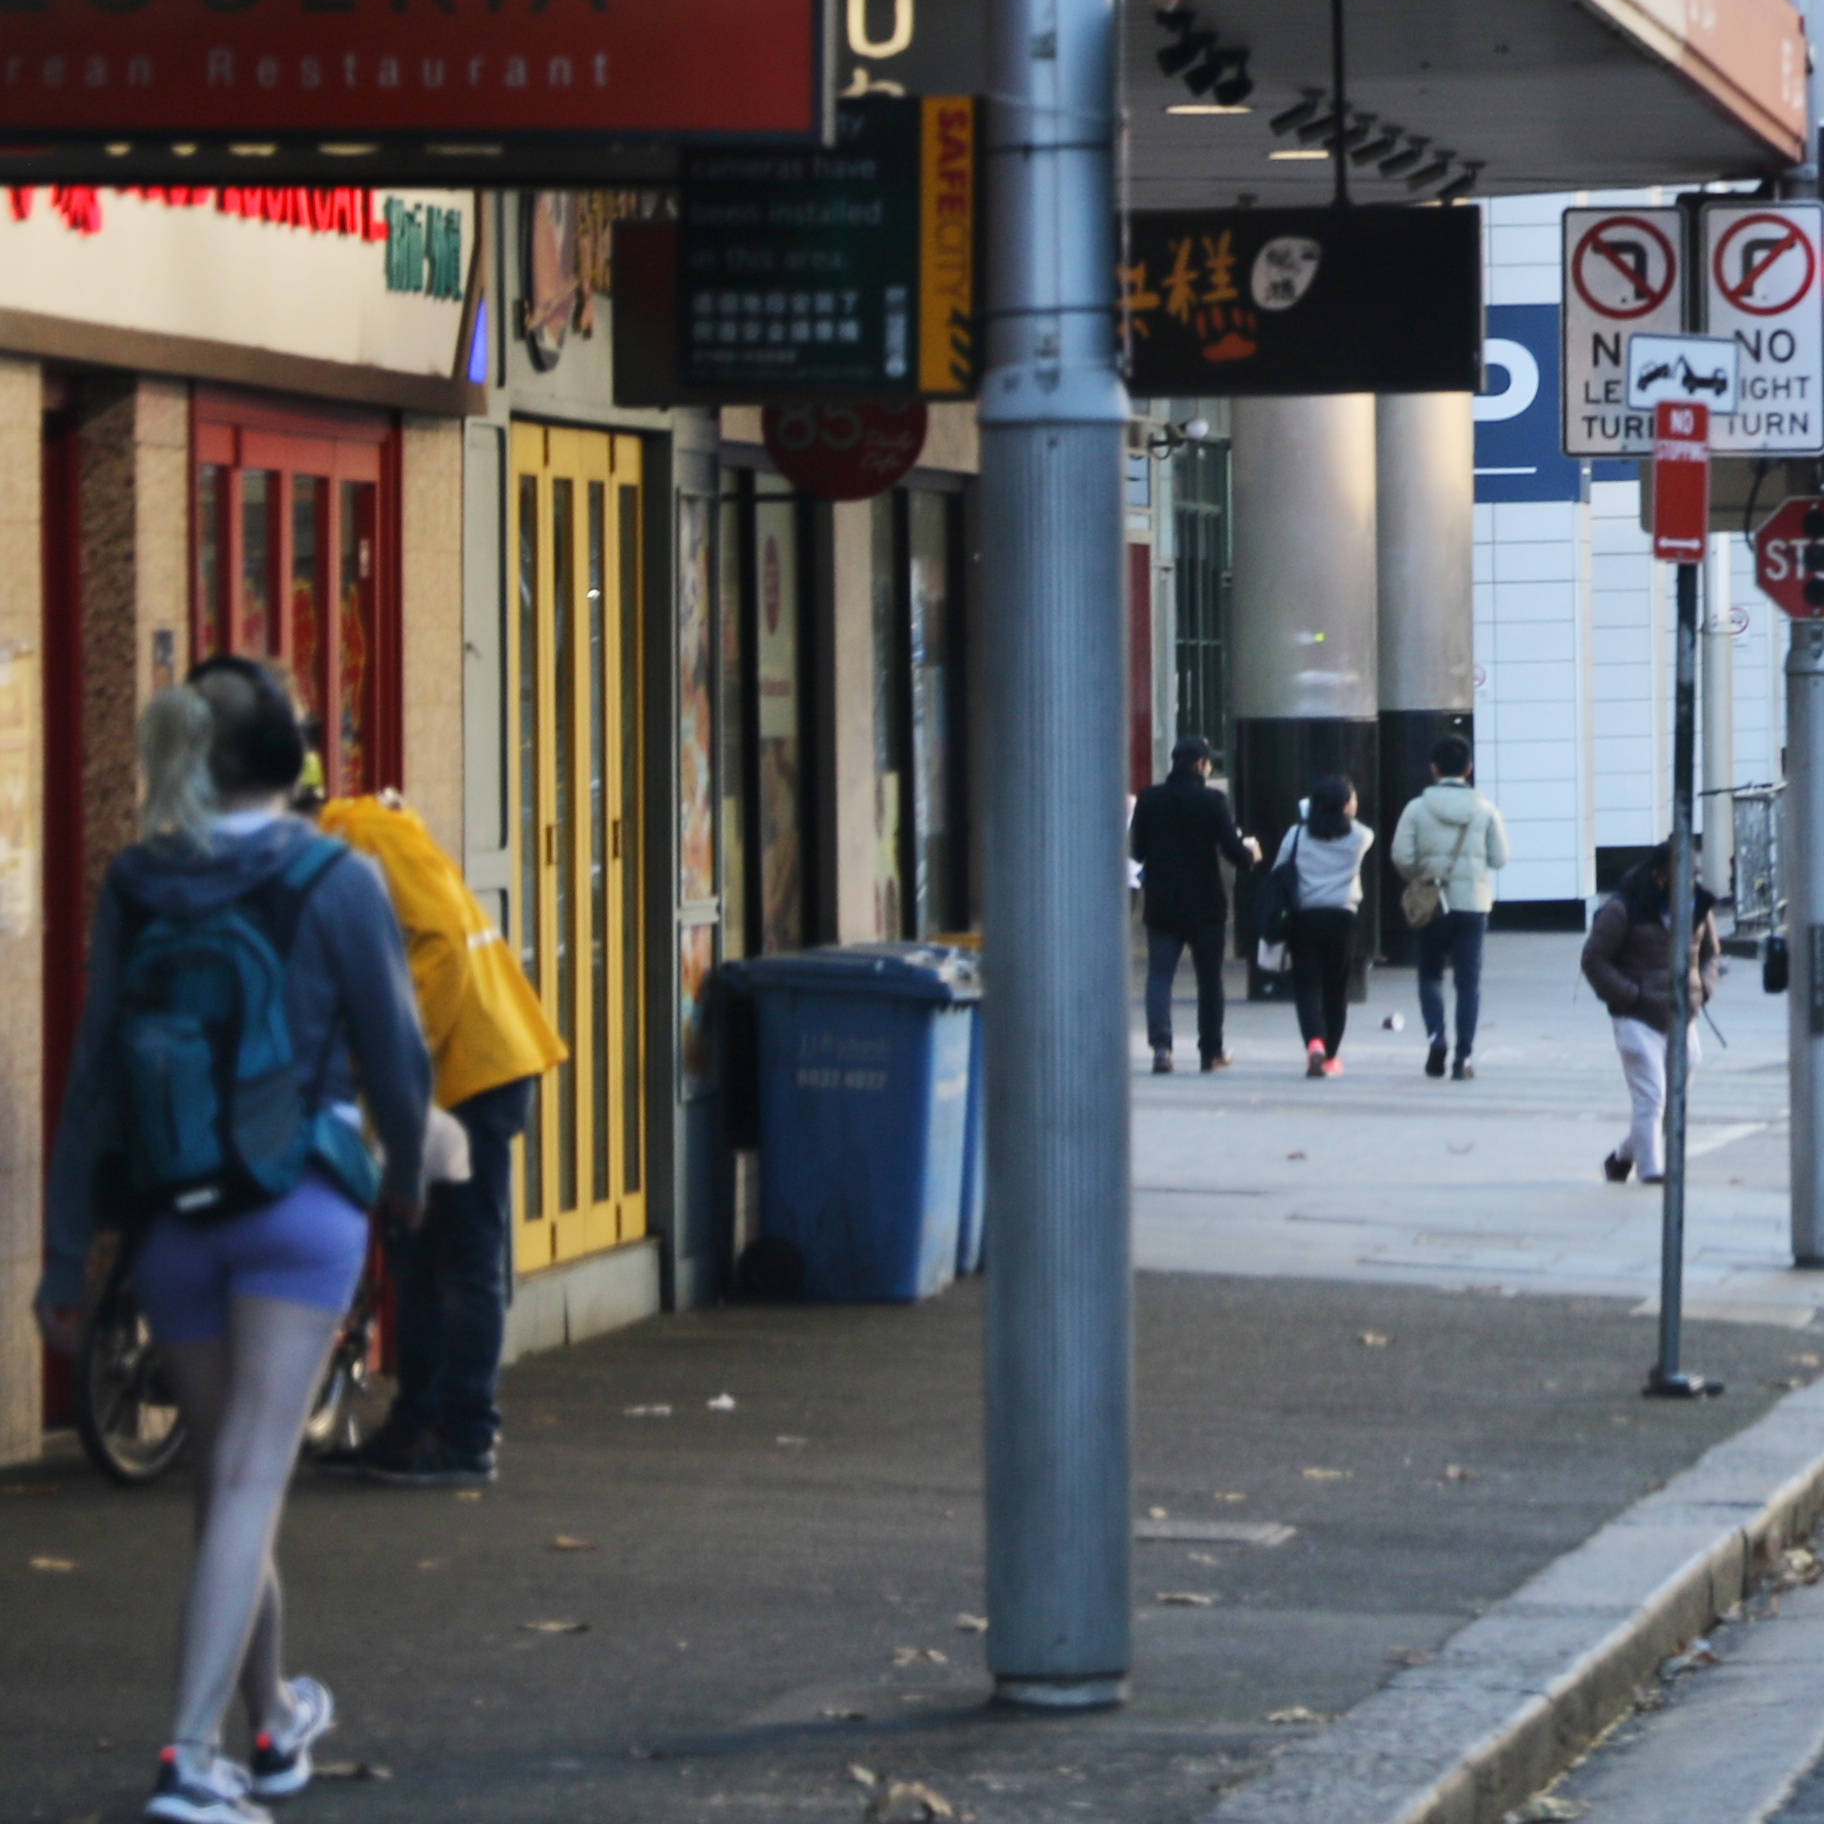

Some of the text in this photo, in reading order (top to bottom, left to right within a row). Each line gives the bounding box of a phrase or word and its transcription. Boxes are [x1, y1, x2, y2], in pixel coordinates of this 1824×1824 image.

[206, 47, 611, 90] Restaurant
[1591, 332, 1622, 368] N
[1734, 329, 1796, 363] NO
[1584, 379, 1622, 405] LE
[1740, 376, 1811, 401] IGHT
[1669, 409, 1695, 435] NO
